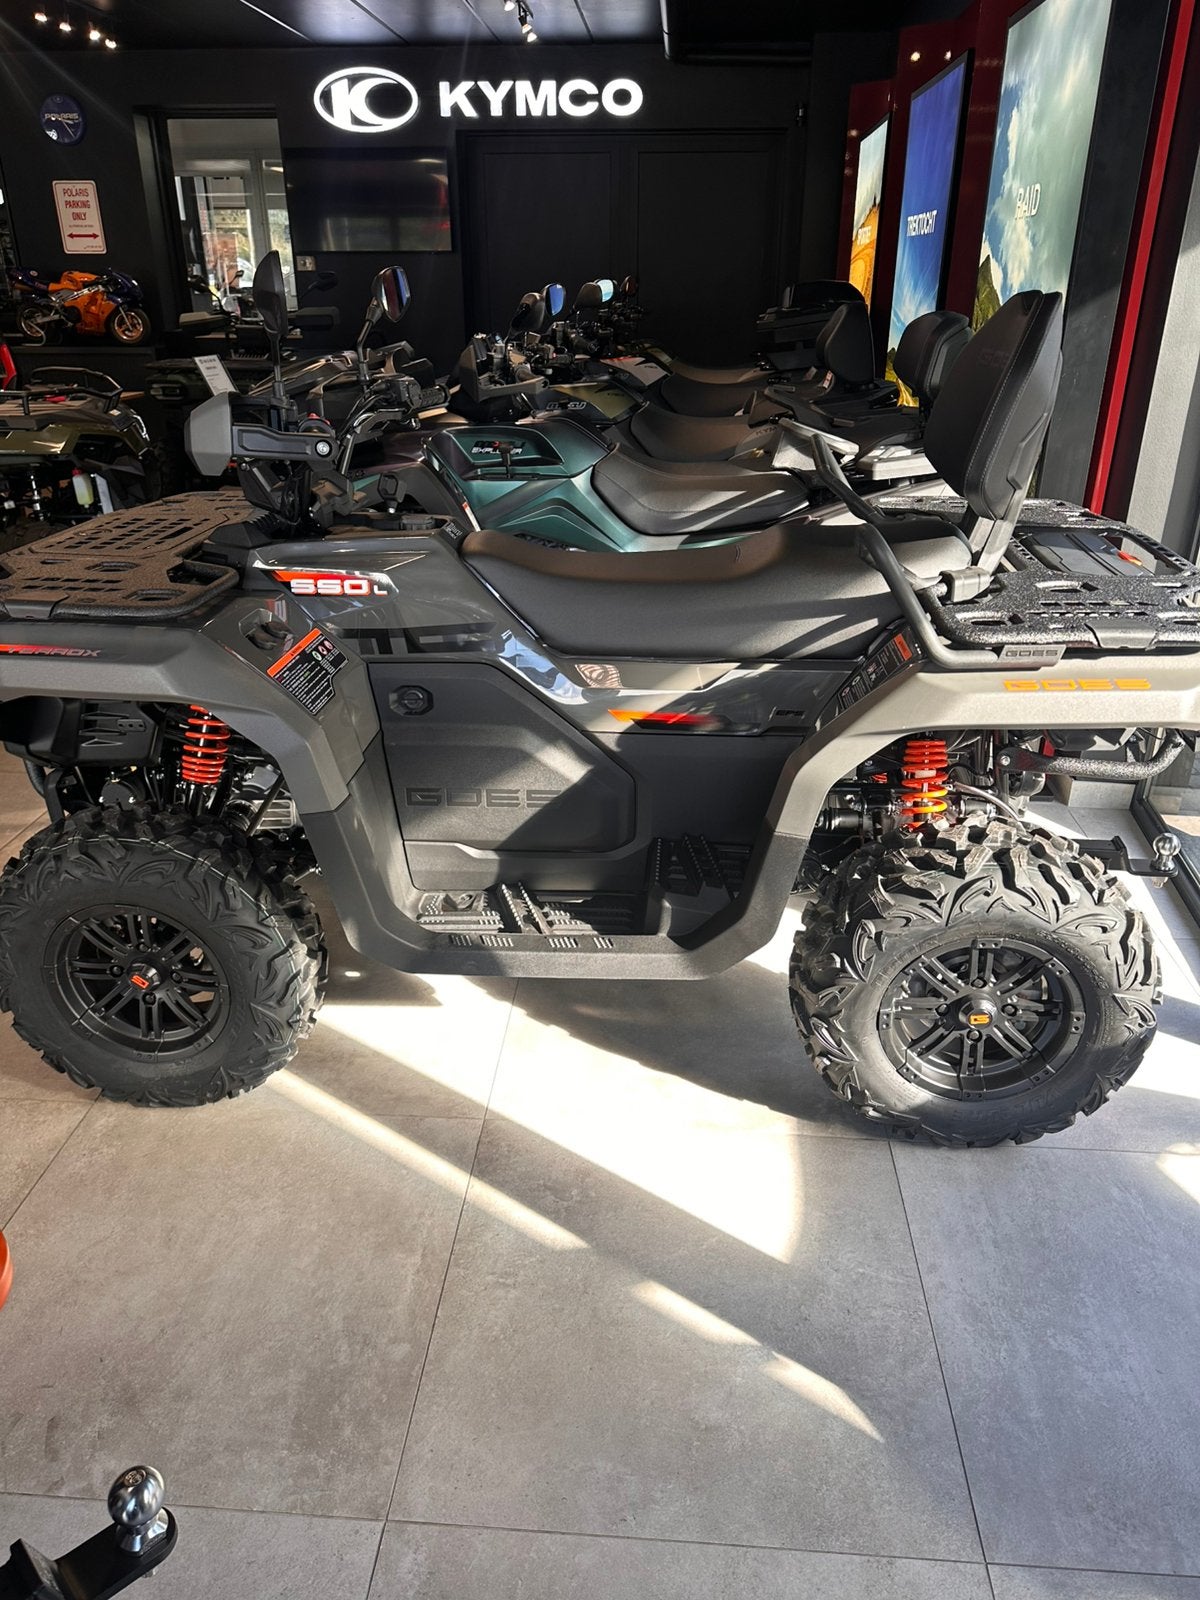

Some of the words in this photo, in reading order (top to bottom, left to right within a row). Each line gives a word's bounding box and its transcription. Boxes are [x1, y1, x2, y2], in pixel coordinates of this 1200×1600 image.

[439, 78, 643, 118] KYMCO
[63, 188, 89, 197] POLARIS
[65, 200, 91, 209] PARKING
[1014, 183, 1041, 219] RAID
[71, 212, 87, 221] ONLY
[907, 209, 938, 237] TREKTOCHT
[290, 578, 373, 596] 550
[1005, 649, 1058, 657] GOES
[1002, 679, 1152, 692] GOES
[405, 787, 563, 808] GOES
